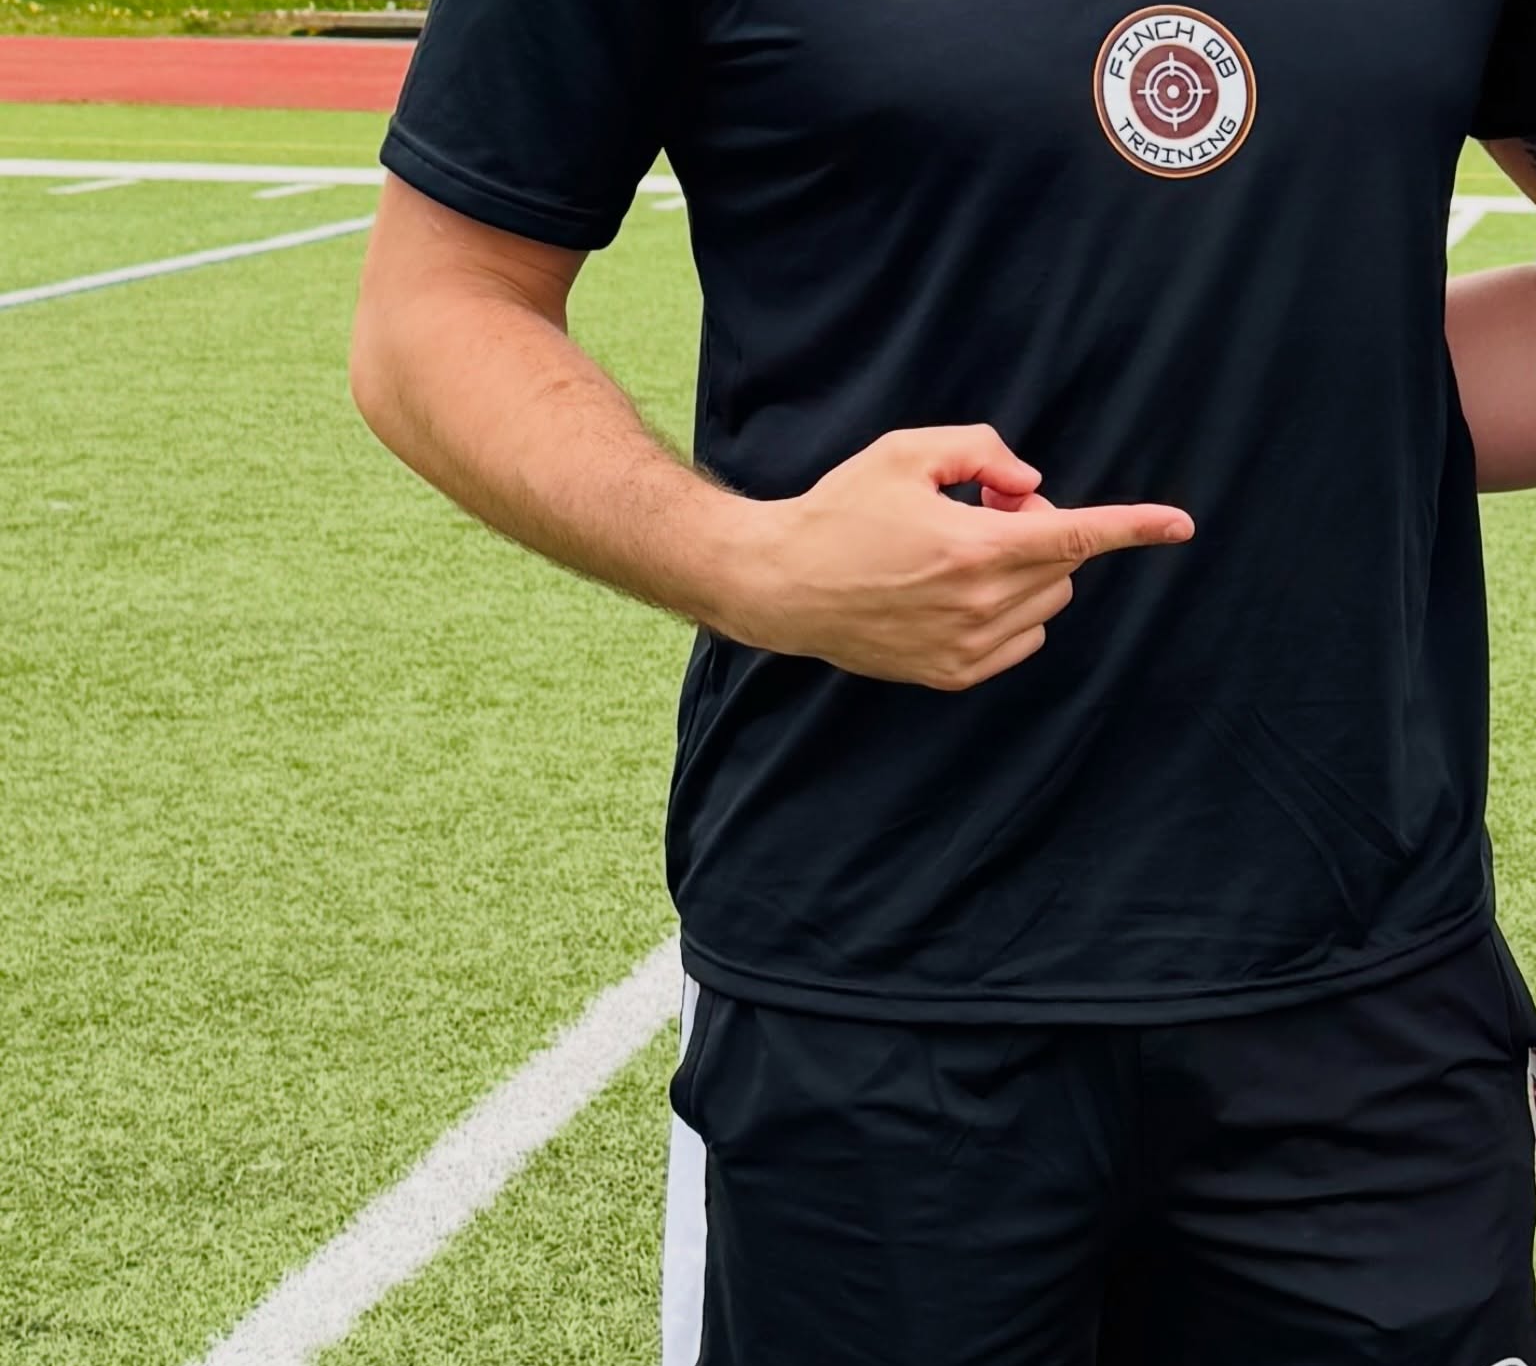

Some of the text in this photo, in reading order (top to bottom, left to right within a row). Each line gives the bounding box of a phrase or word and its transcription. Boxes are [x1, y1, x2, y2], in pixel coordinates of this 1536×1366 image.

[1109, 20, 1237, 80] FINCH QB
[1118, 115, 1237, 164] TRAINING
